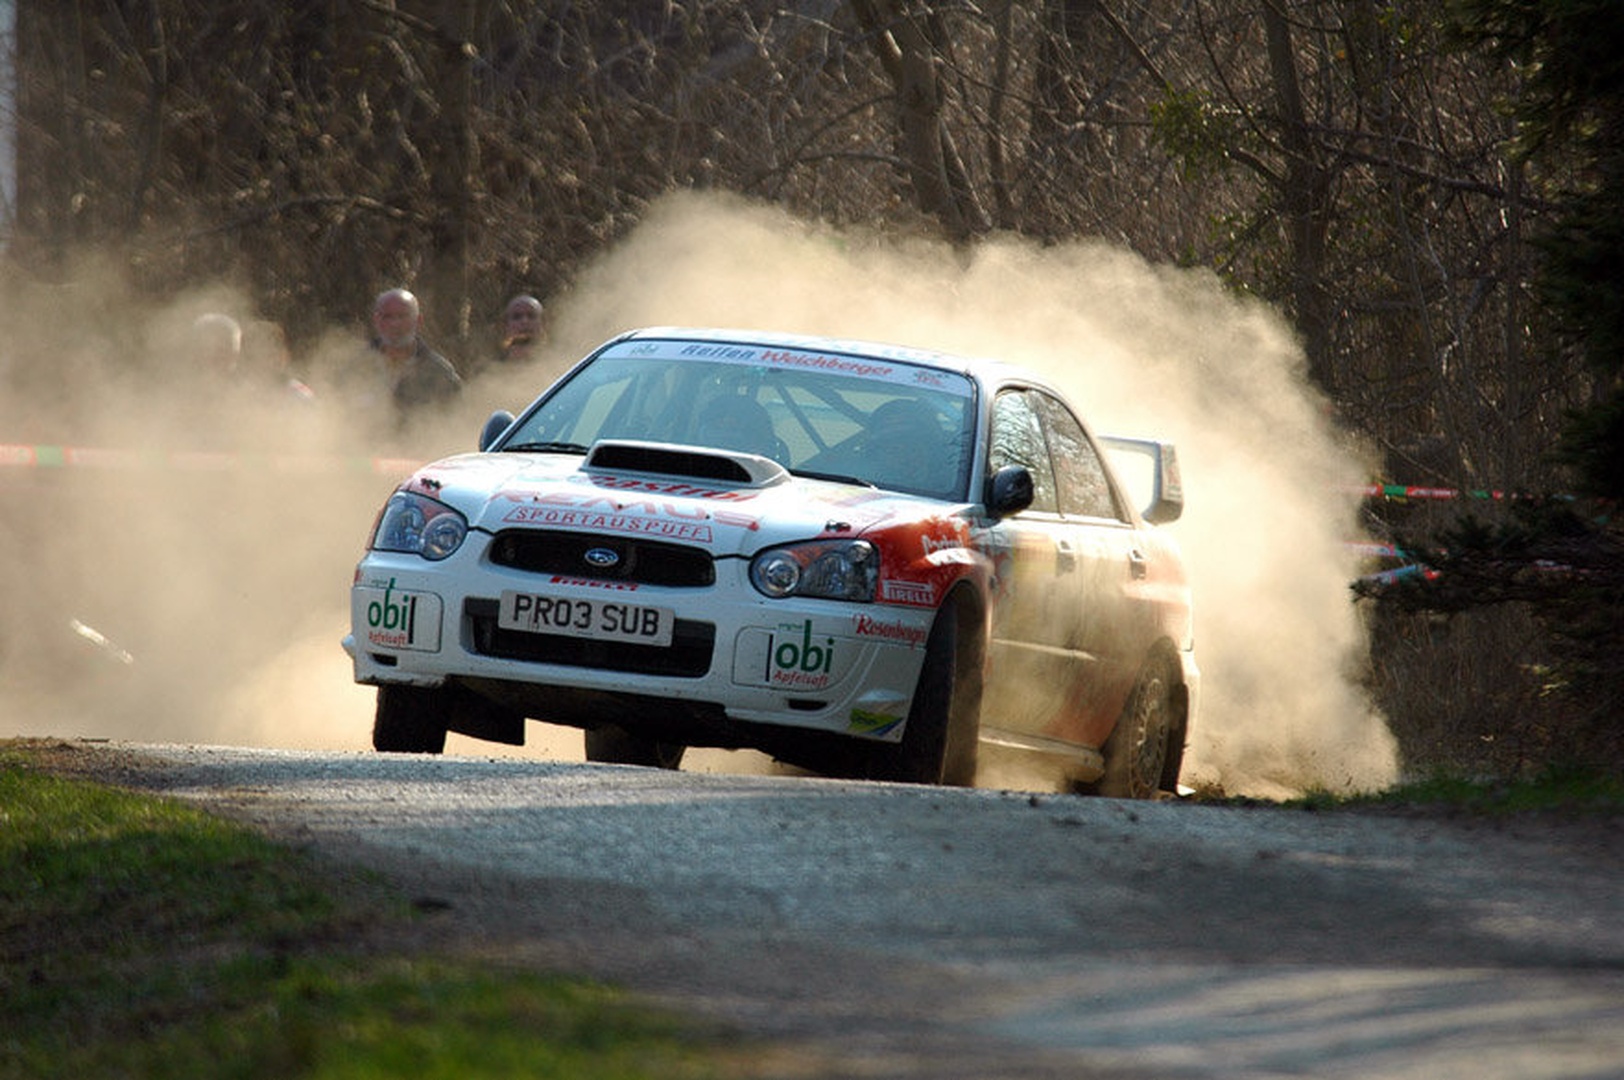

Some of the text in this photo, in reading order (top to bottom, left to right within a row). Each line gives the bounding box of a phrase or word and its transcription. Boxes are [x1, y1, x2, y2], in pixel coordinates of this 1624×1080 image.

[680, 344, 756, 360] Reifen
[516, 507, 703, 539] SPORTAUSPUFF
[601, 603, 661, 638] SUB
